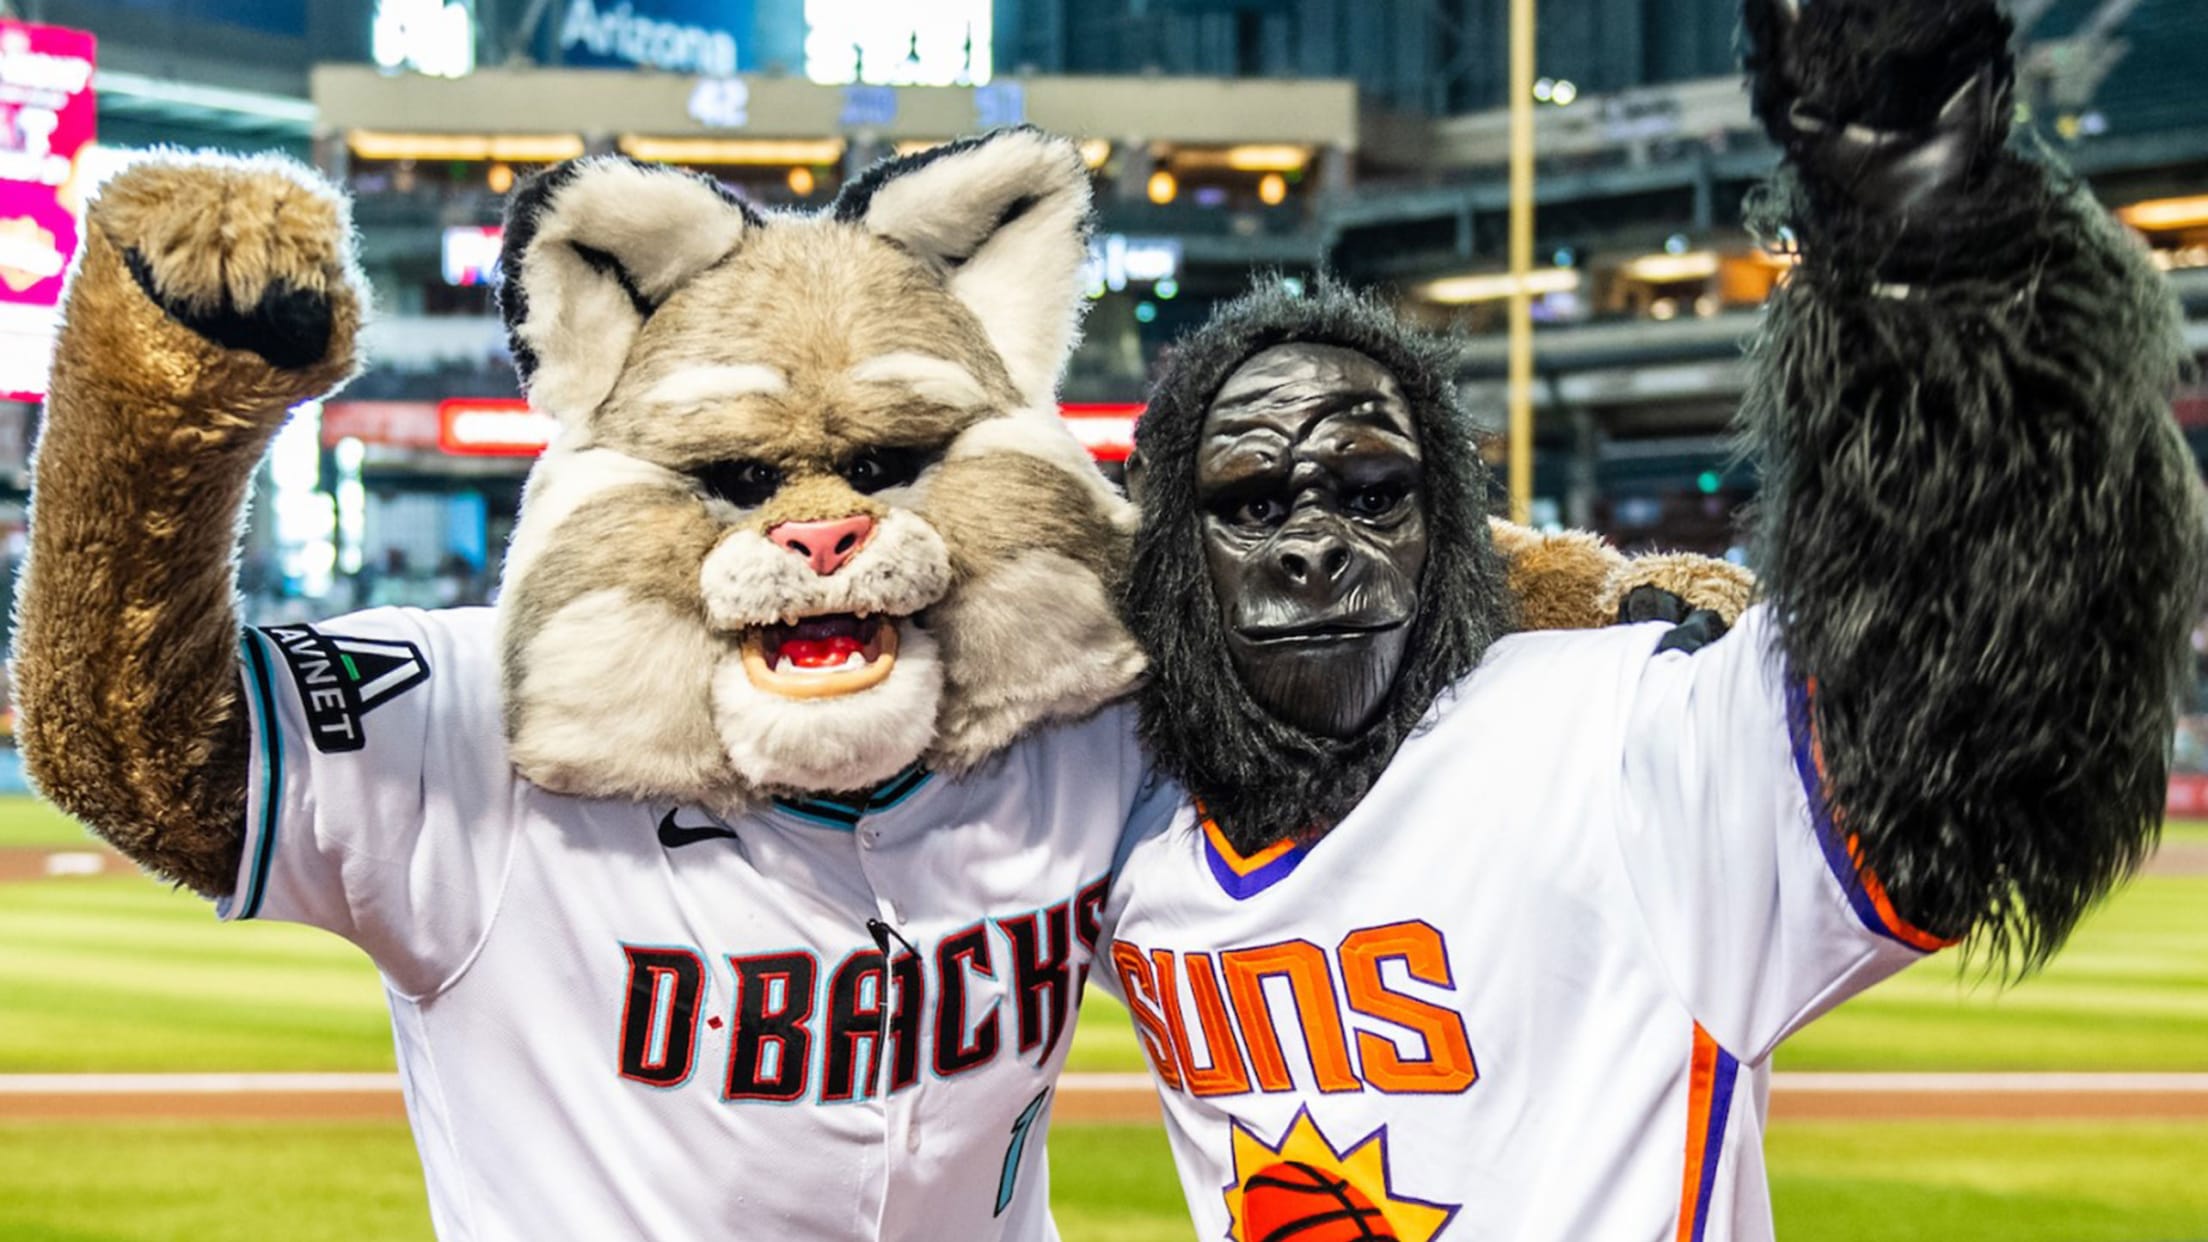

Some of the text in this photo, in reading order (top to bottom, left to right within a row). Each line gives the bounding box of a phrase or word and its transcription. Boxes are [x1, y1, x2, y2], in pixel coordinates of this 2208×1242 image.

[560, 0, 737, 76] Arizona
[688, 78, 748, 126] 42
[269, 628, 355, 740] AVNET
[1111, 918, 1480, 1098] SUNS
[994, 1085, 1049, 1218] 1
